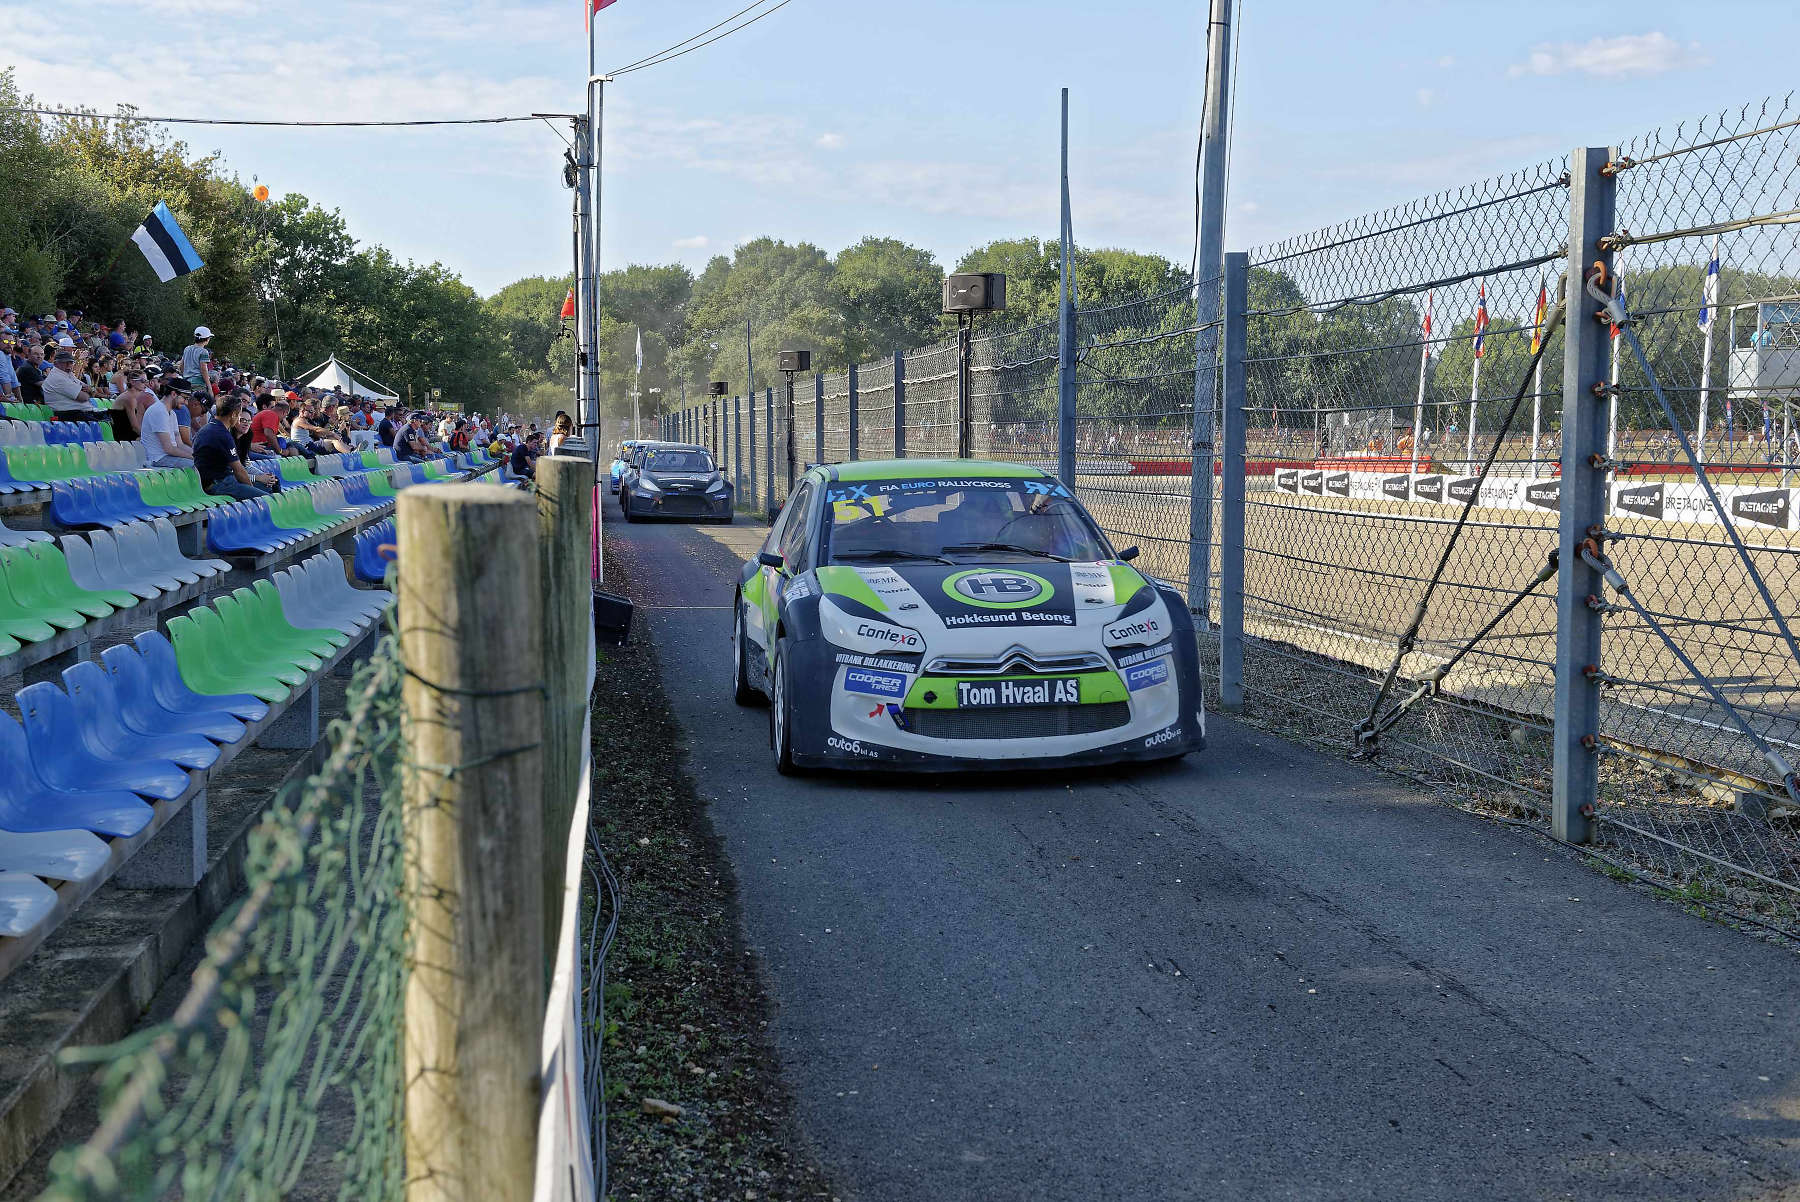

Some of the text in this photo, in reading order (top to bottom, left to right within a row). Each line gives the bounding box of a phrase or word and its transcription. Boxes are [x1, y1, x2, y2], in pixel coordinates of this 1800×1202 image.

[879, 481, 1012, 492] FIA EURO RALLYCROSS
[1622, 494, 1656, 506] BRETAGNE
[1665, 496, 1713, 512] BRETAGNE
[1739, 501, 1778, 514] BRETAGNE
[965, 577, 1035, 595] HB
[945, 612, 1073, 626] Hokksund Betong
[857, 624, 918, 646] Contexo
[1109, 620, 1159, 640] Contexo
[848, 672, 902, 687] COOPER
[1130, 663, 1167, 681] COOPER
[959, 679, 1078, 705] Tom Hvaal AS
